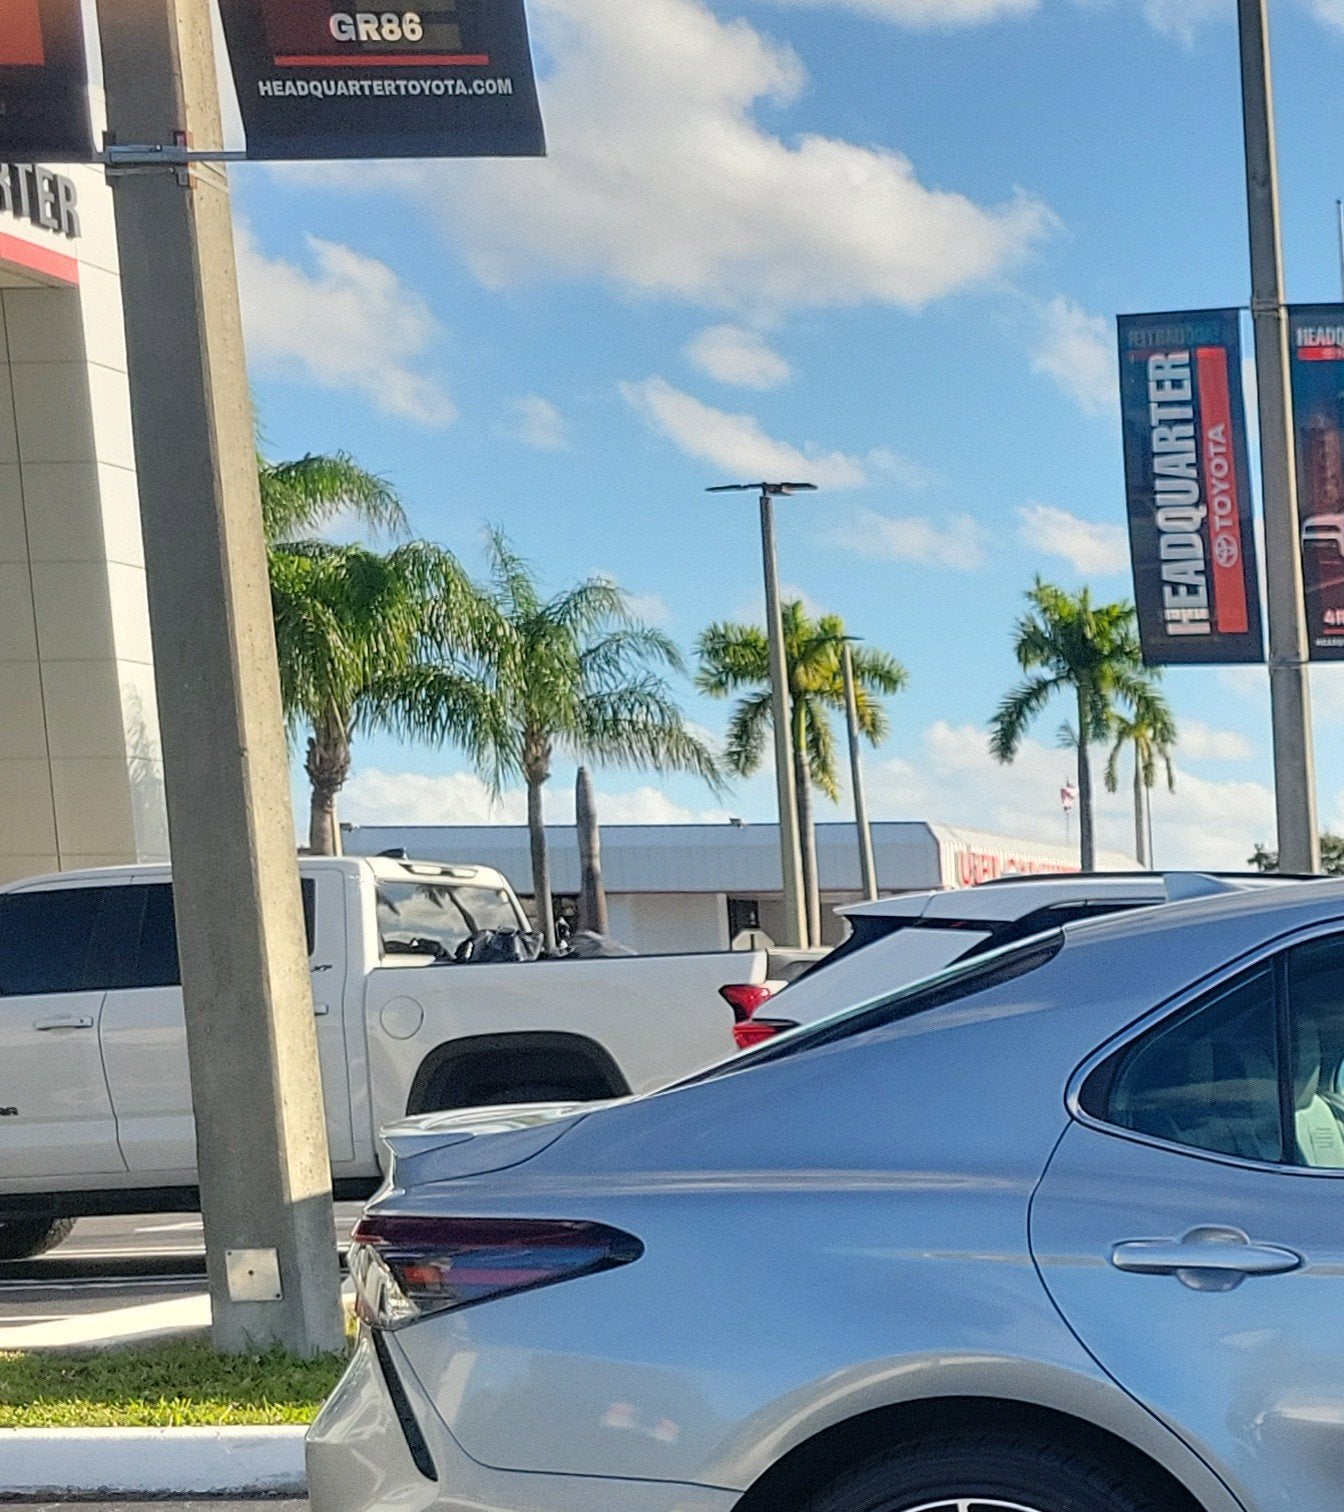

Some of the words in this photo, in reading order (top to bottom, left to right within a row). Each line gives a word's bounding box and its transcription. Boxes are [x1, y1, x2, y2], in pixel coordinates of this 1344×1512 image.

[329, 12, 424, 42] GR86
[258, 78, 514, 99] HEADQUARTERTOYOTA.COM
[1148, 350, 1211, 635] HEADQUARTER
[1207, 423, 1235, 531] TOYOTA
